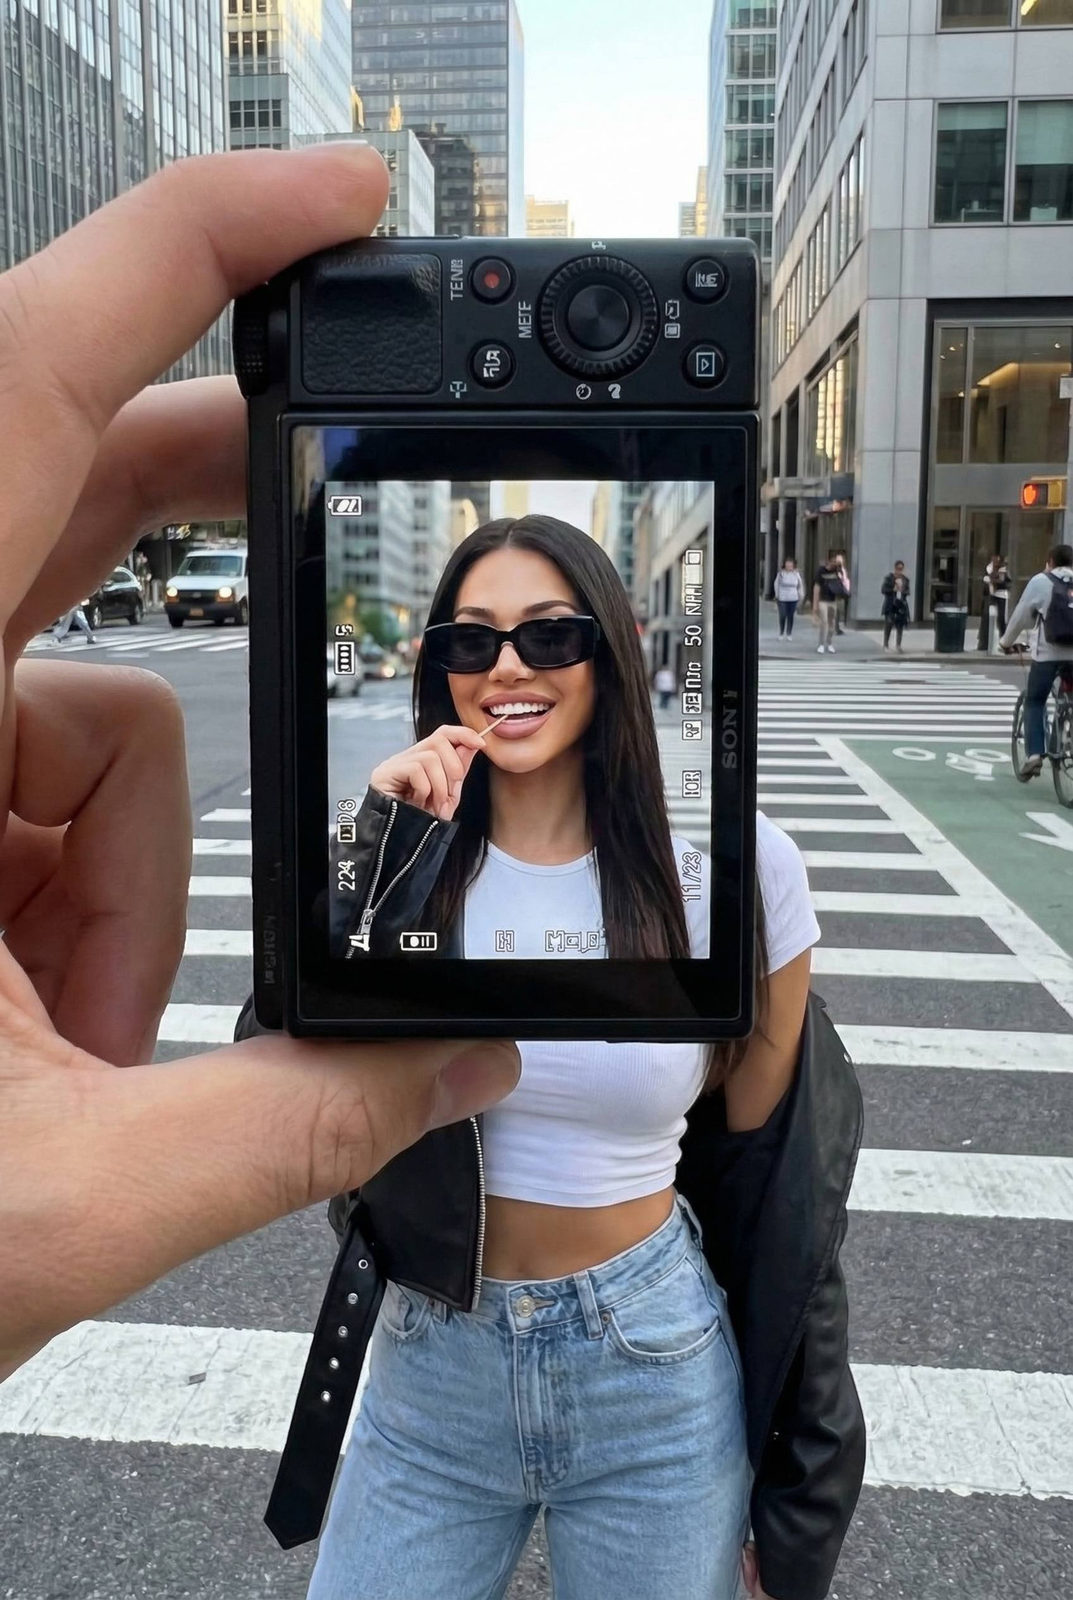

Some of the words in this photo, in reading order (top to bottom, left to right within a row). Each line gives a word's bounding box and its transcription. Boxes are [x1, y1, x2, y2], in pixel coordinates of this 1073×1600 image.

[684, 624, 702, 646] 50
[337, 859, 356, 891] 224
[682, 851, 702, 903] 11/23
